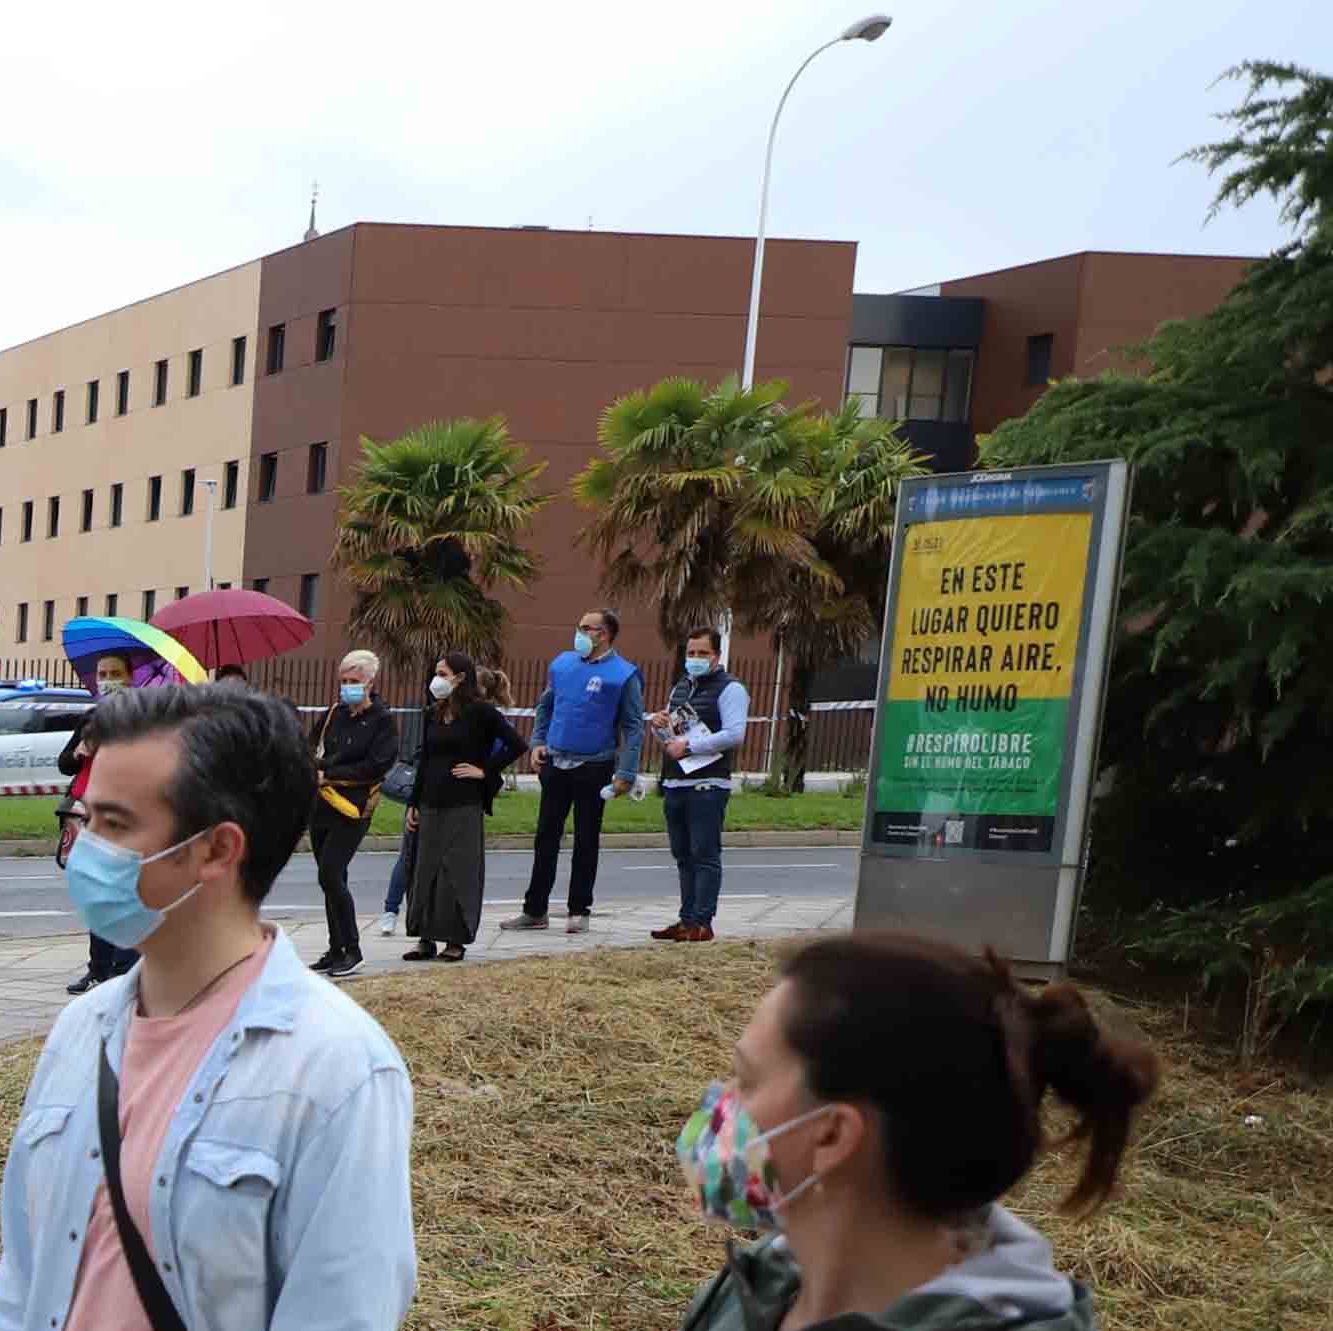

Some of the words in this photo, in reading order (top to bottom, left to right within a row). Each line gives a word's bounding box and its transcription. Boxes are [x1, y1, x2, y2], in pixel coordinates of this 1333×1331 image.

[940, 567, 965, 594] EN
[972, 563, 1026, 592] ESTE
[911, 606, 969, 636] LUGAR
[976, 602, 1060, 637] QUIERO
[901, 645, 993, 674] RESPIRAR
[925, 685, 949, 713] NO
[956, 684, 1019, 713] HUMO
[906, 733, 1032, 753] #RESPIROLIBRE
[964, 756, 982, 769] DEL
[989, 755, 1031, 769] TABACO
